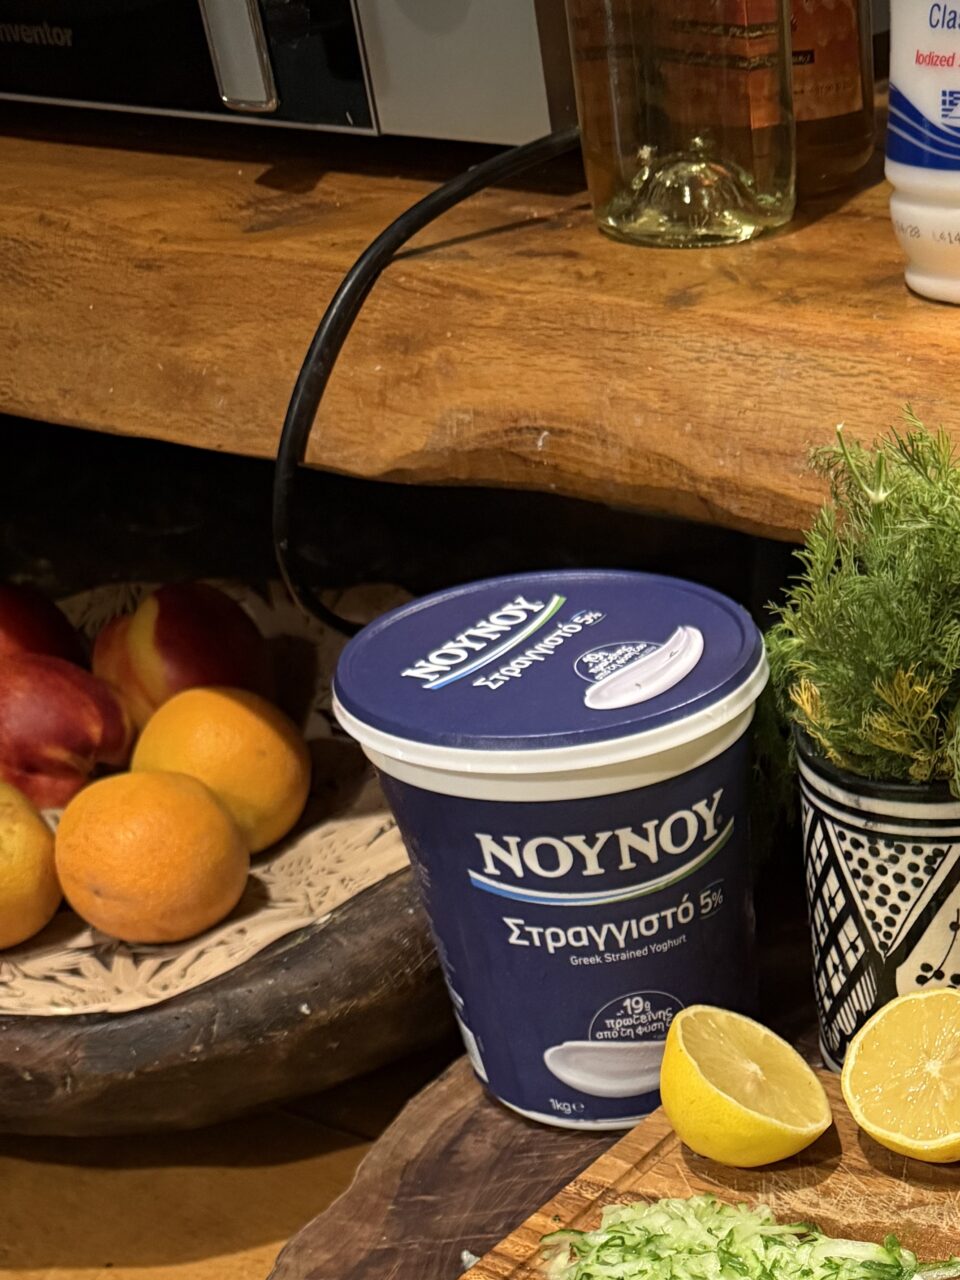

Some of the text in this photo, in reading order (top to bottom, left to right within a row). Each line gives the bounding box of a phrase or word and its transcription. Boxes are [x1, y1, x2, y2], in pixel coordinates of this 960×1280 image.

[915, 49, 956, 67] Iodized
[473, 622, 583, 690] Στραγγιστό
[502, 889, 724, 954] Στραγγιστό 5%
[570, 934, 688, 966] Greek Strained Yoghurt
[596, 1028, 618, 1040] από
[620, 1027, 635, 1039] τη
[636, 1022, 665, 1036] φύση
